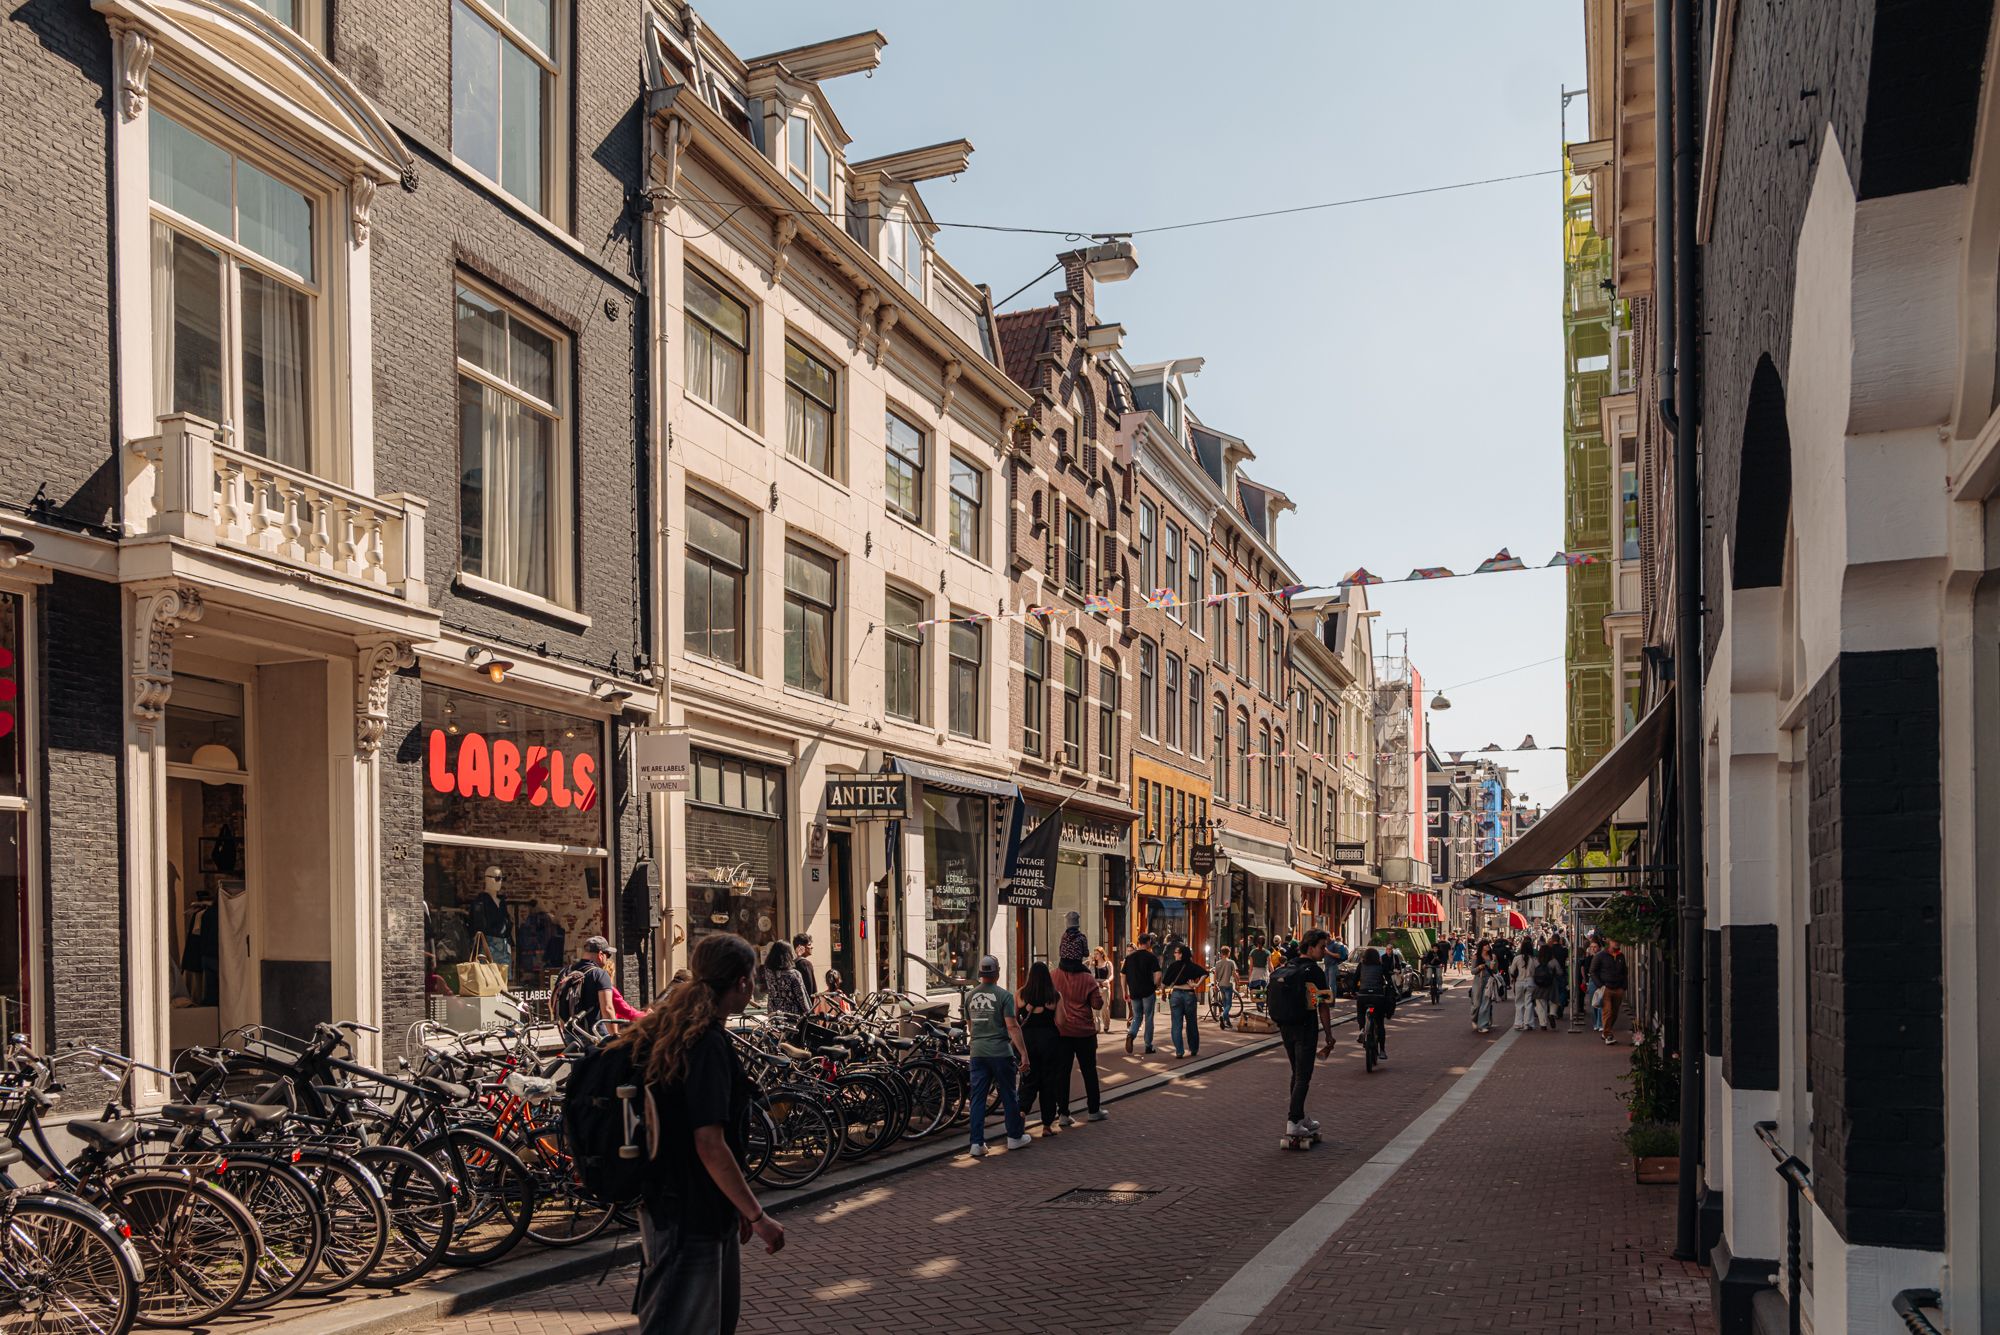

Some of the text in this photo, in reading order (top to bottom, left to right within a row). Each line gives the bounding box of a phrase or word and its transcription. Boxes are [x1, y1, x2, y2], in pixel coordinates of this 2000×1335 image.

[429, 729, 596, 812] LABELS
[650, 782, 678, 790] WOMEN
[831, 786, 898, 805] ANTIEK
[1061, 821, 1080, 840] ART
[1082, 825, 1120, 846] GALLERY
[1016, 857, 1045, 866] INTAGE
[1014, 868, 1045, 878] HANEL
[1013, 888, 1037, 896] LOUIS
[1008, 896, 1043, 906] VUITTON
[525, 989, 552, 1001] LABELS
